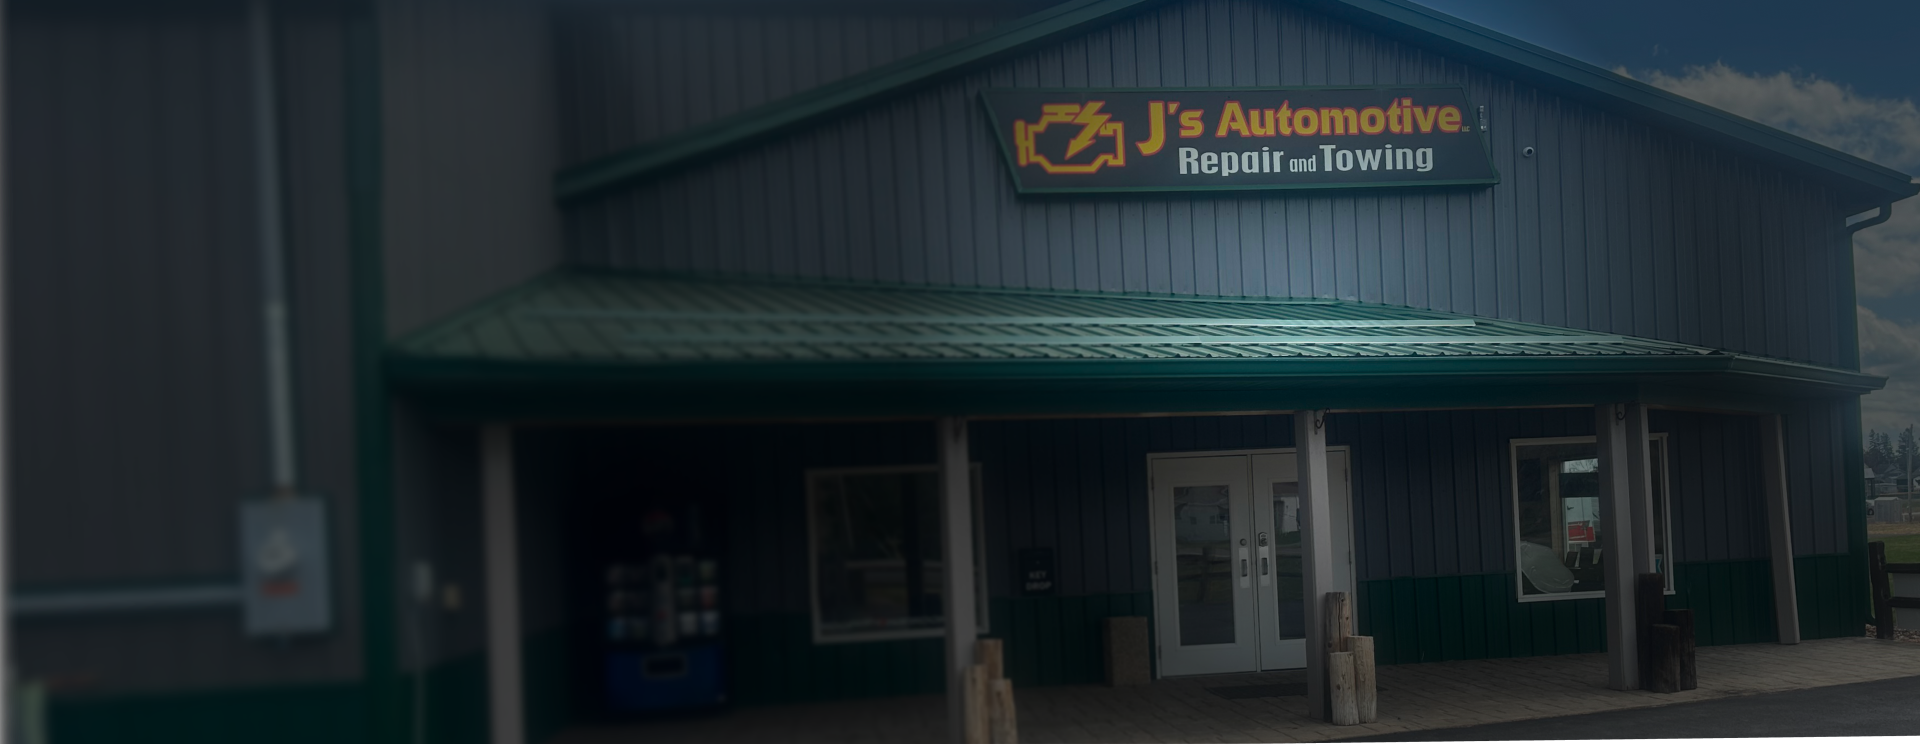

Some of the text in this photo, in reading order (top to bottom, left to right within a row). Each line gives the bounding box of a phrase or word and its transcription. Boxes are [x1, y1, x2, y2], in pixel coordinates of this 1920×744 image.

[1135, 101, 1205, 156] J's
[1215, 98, 1462, 138] Automotive
[1178, 144, 1433, 176] Repair and Towing
[1025, 580, 1052, 591] DROP
[1029, 570, 1047, 580] KEY
